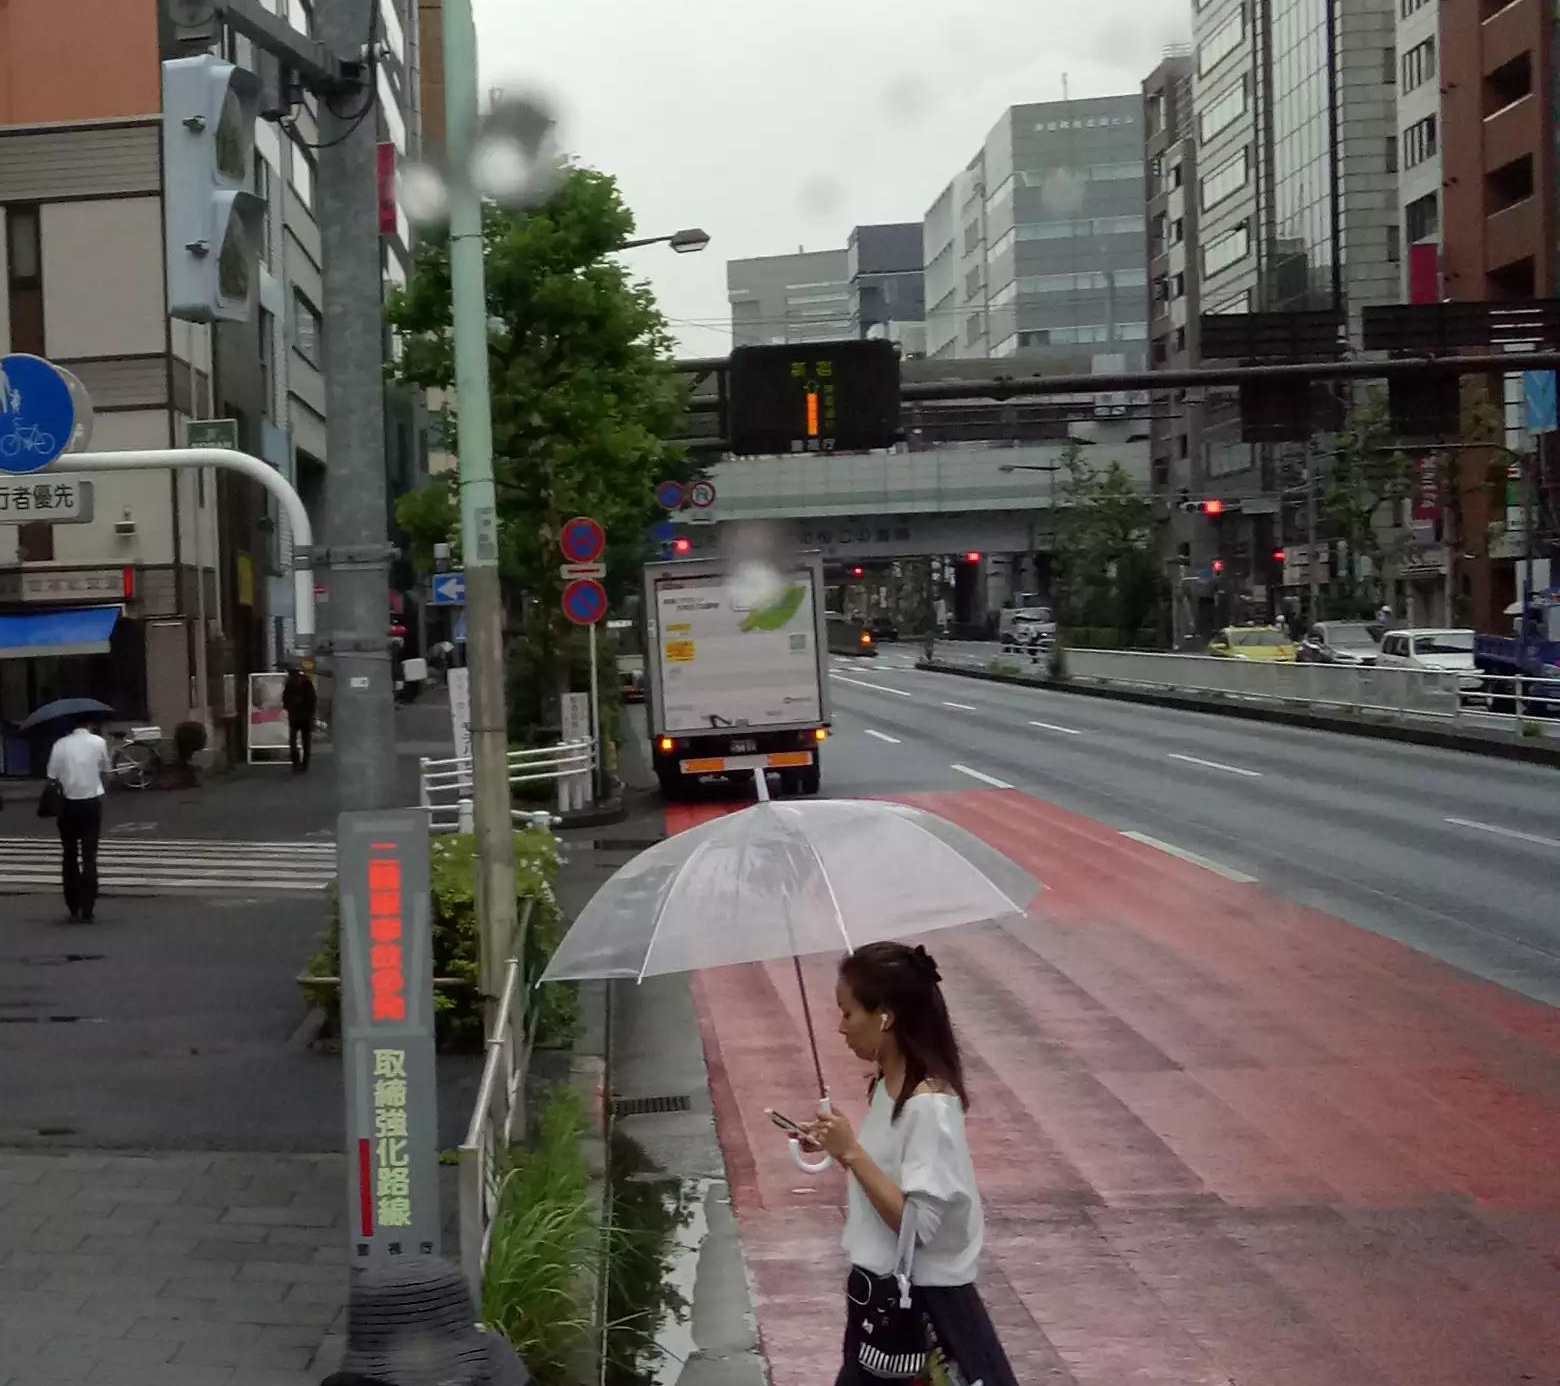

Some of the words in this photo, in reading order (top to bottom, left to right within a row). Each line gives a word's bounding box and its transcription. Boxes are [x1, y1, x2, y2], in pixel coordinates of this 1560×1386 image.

[373, 1049, 412, 1227] 取締強化路線
